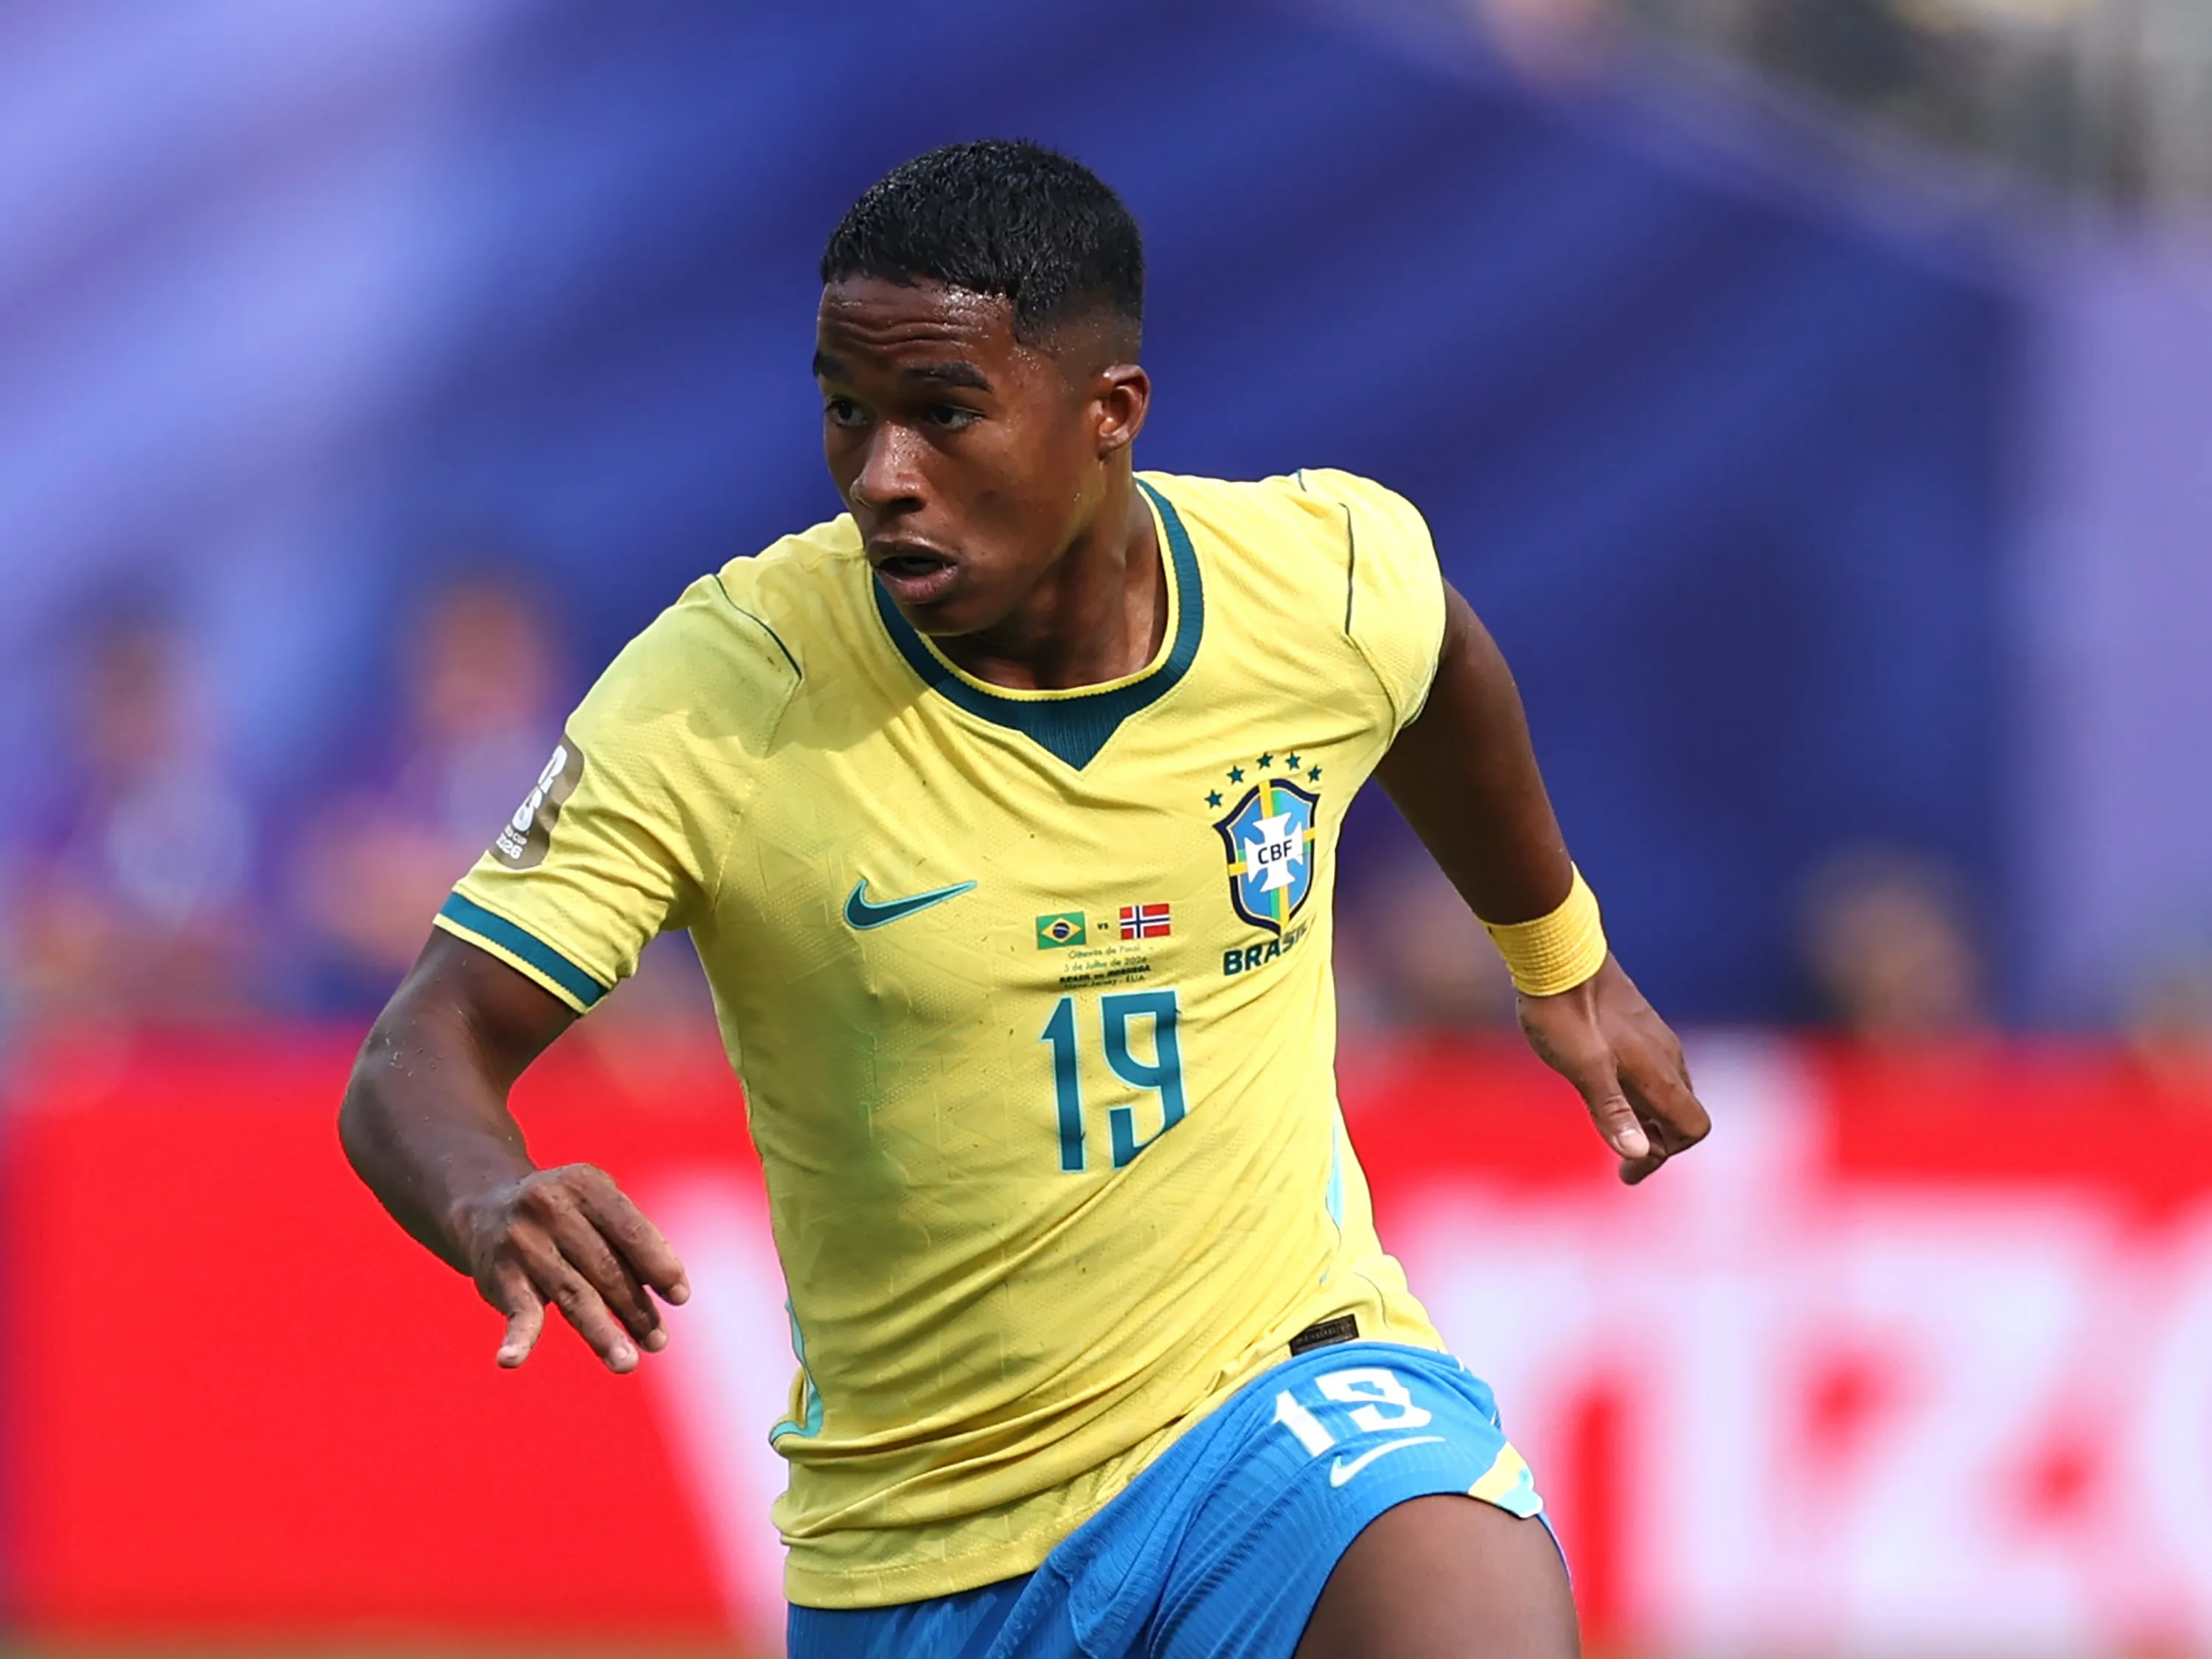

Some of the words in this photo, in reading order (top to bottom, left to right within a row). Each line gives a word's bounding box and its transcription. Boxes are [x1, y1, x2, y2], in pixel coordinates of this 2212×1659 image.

[1258, 839, 1293, 865] CBF
[1039, 989, 1187, 1173] 19
[1271, 1368, 1433, 1458] 19
